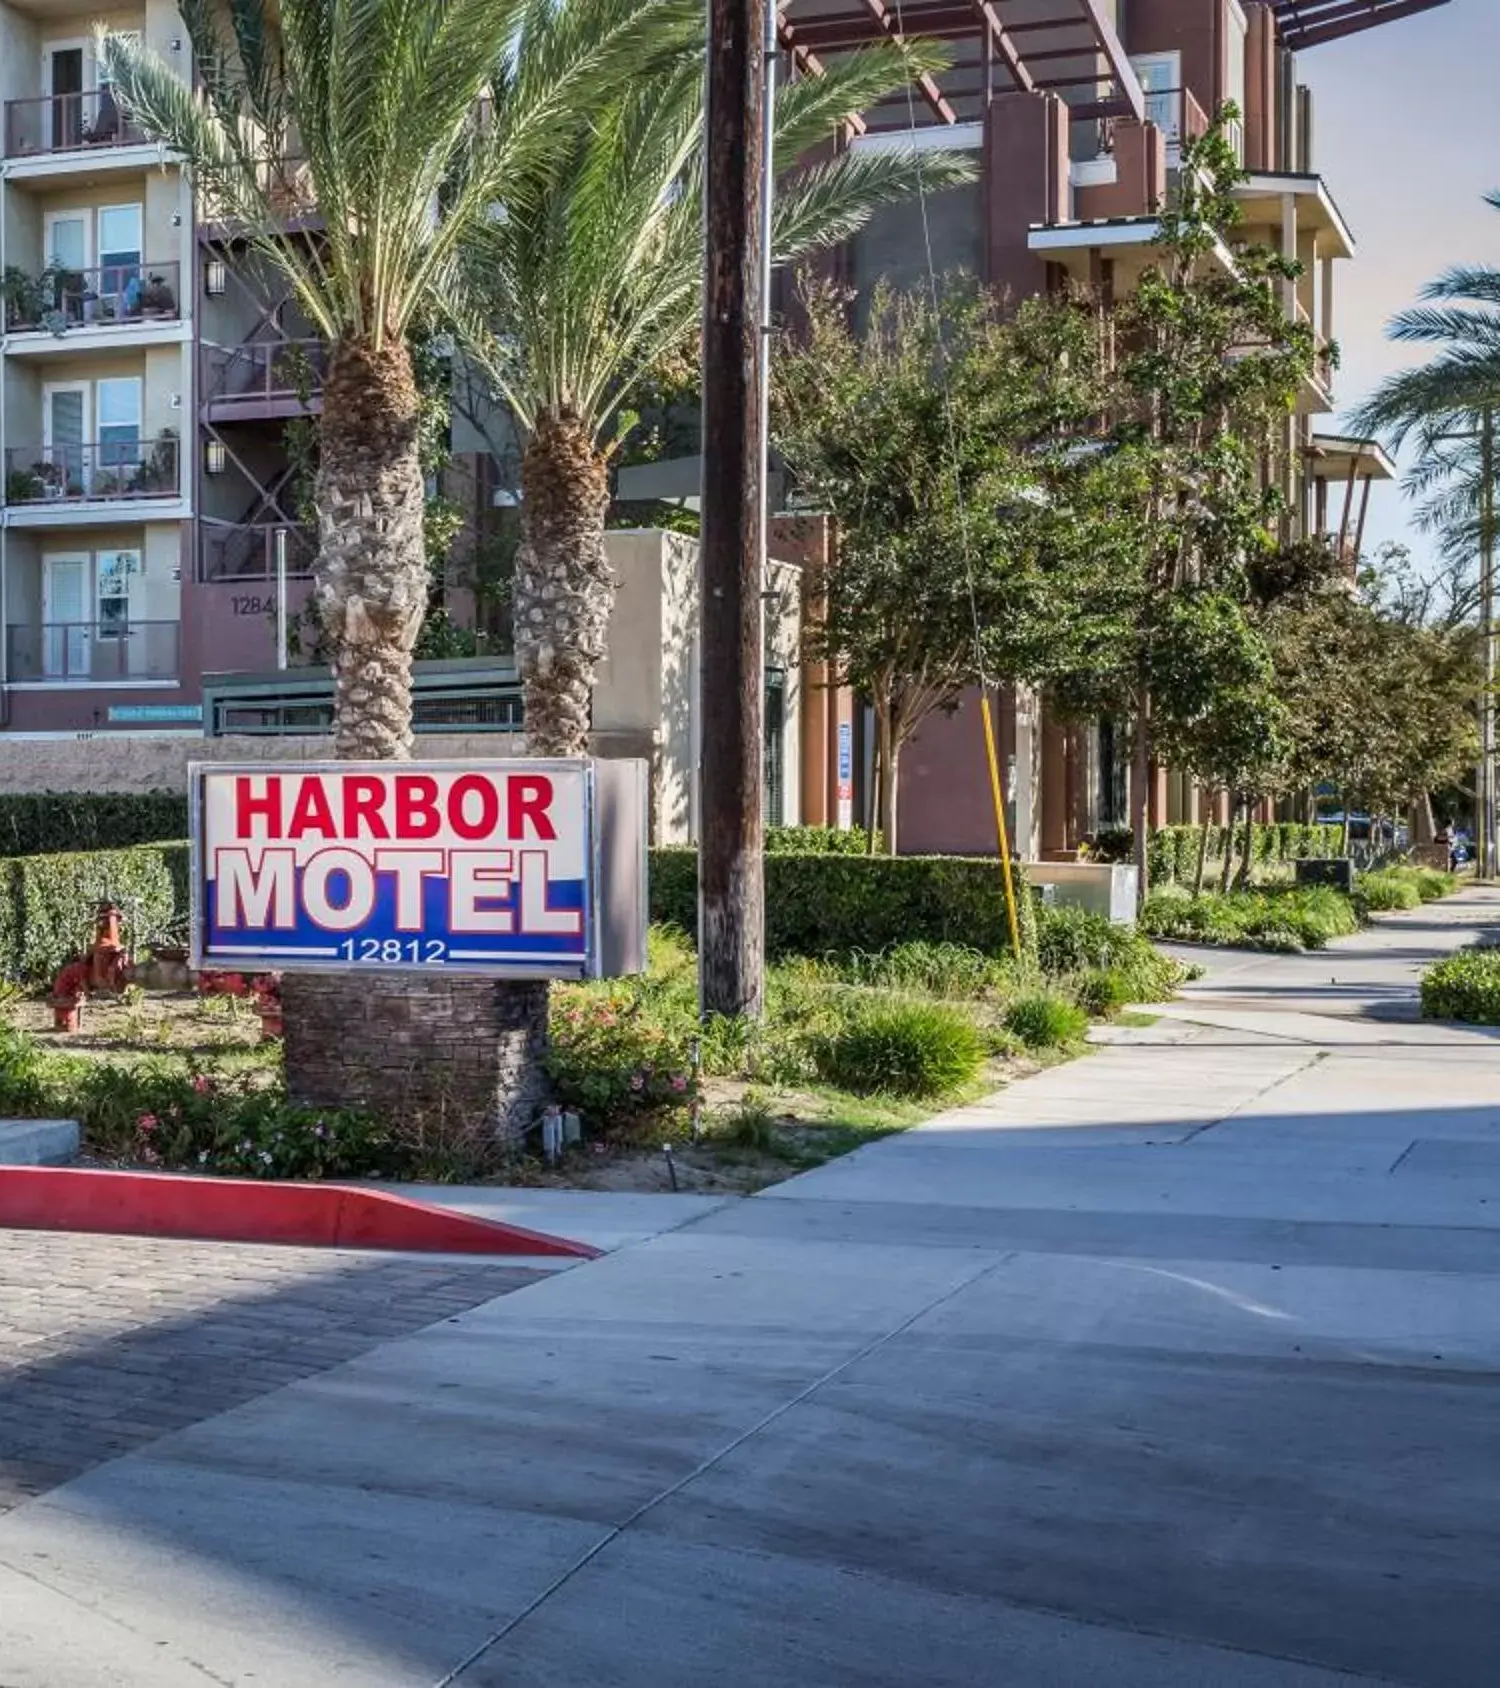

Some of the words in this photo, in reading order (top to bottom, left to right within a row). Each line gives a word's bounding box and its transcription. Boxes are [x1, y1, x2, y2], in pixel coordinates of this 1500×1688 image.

[236, 775, 557, 840] HARBOR
[214, 846, 583, 935] MOTEL
[341, 938, 446, 963] 12812
